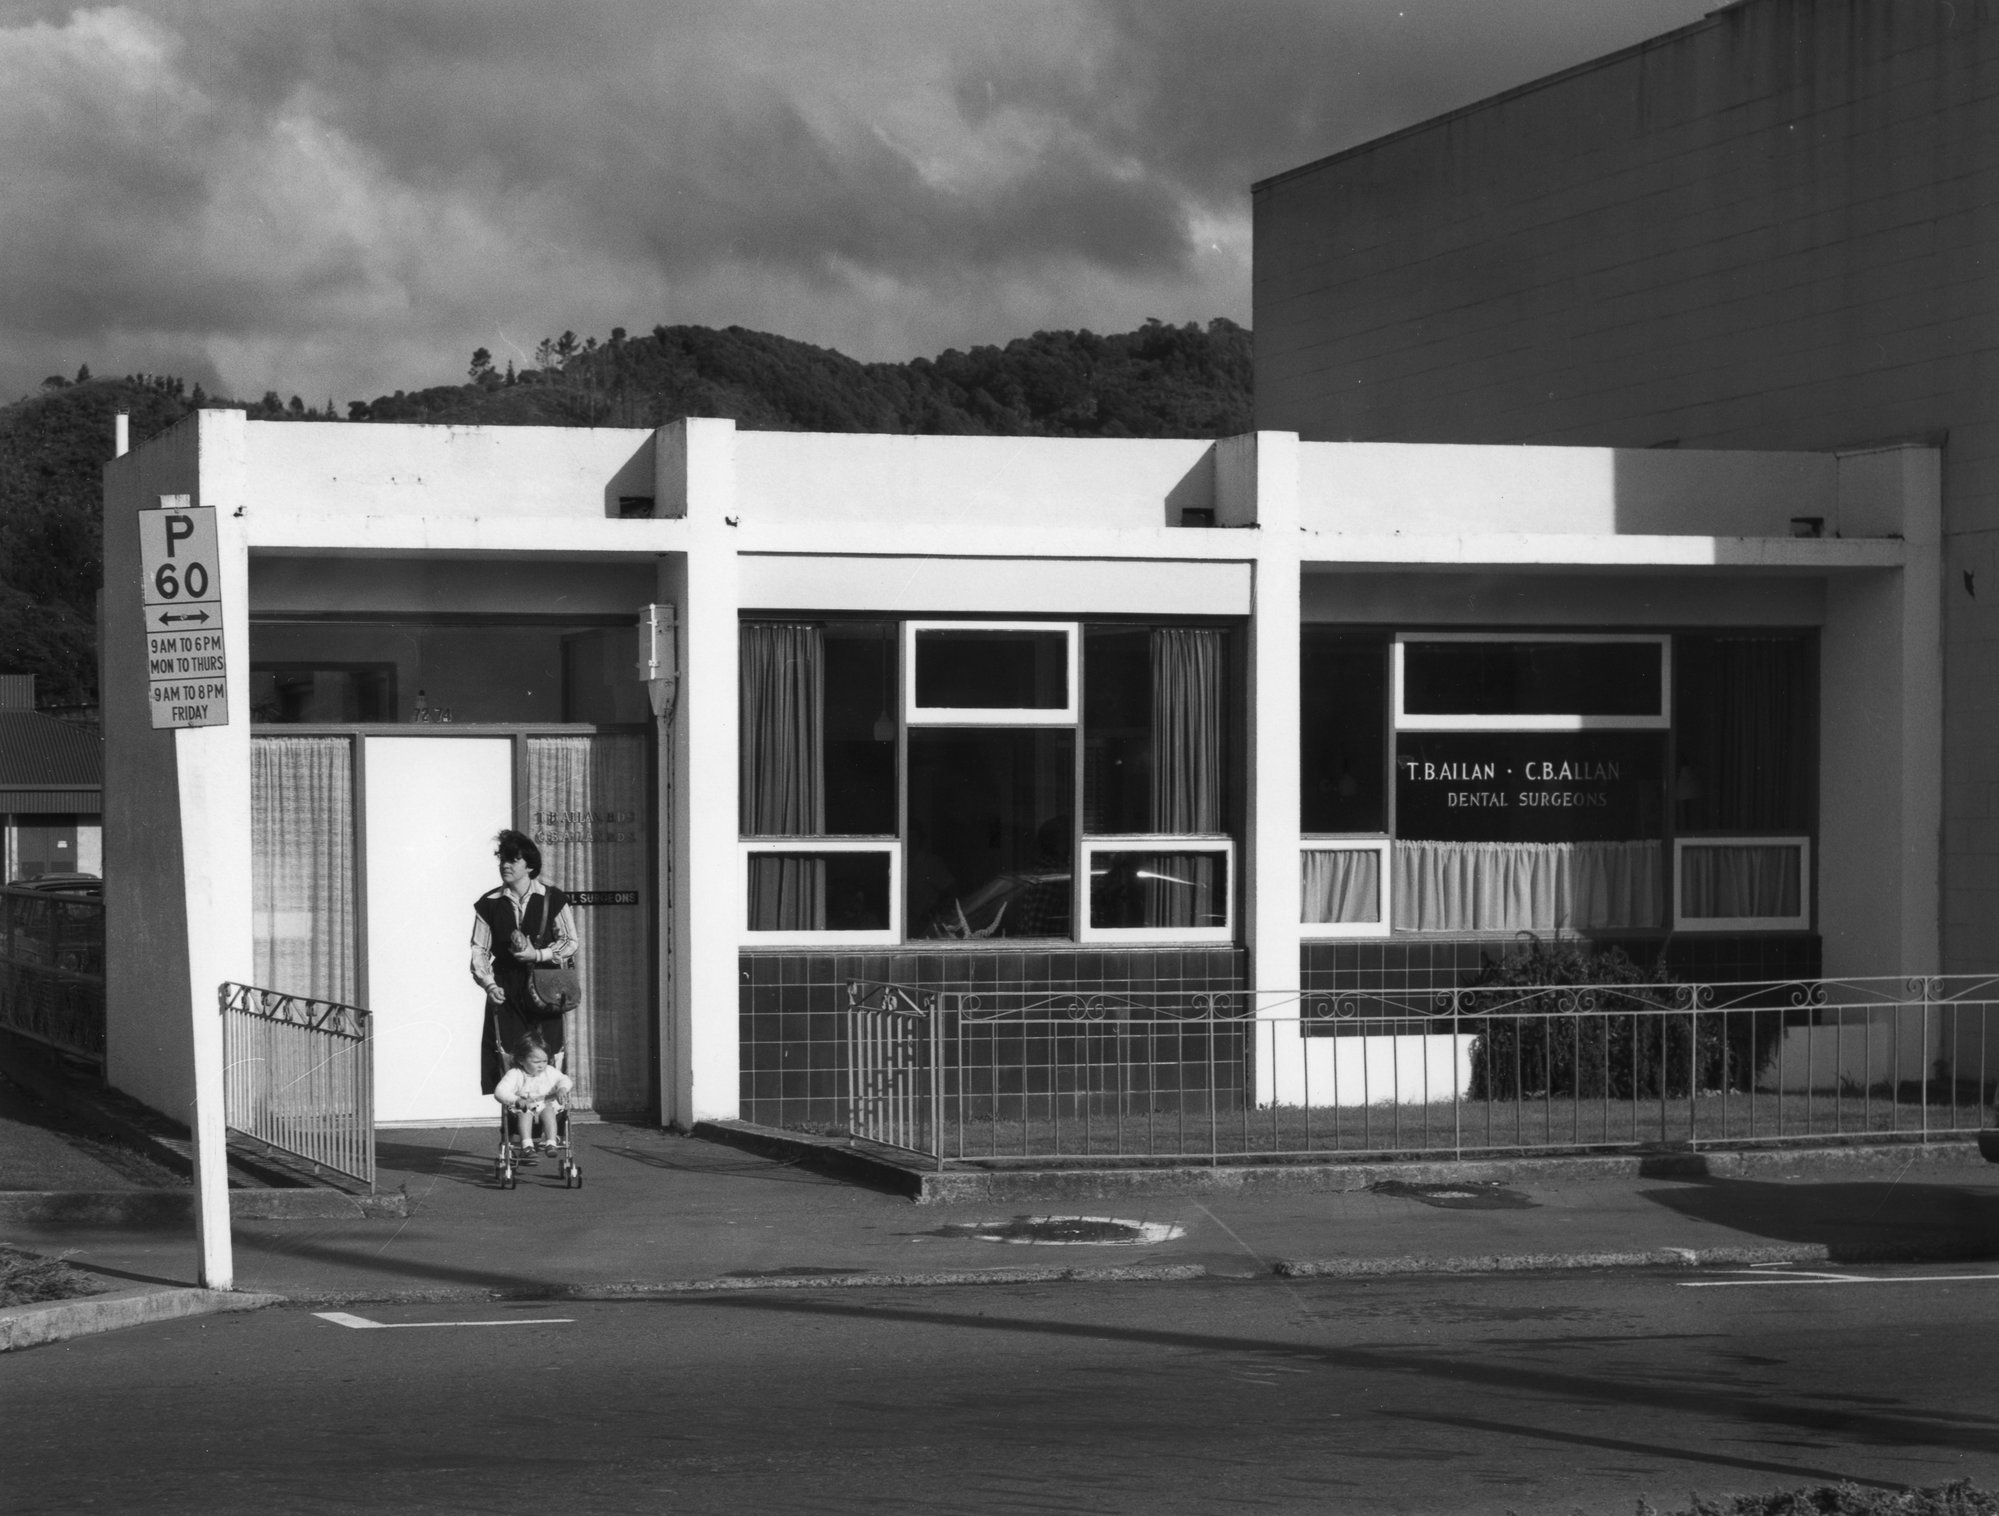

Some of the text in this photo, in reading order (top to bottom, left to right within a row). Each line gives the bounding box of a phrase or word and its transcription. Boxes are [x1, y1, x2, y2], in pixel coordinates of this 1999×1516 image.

[165, 515, 194, 558] P
[155, 562, 209, 599] 60
[180, 637, 193, 652] TO
[150, 656, 224, 674] MON TO THURS
[183, 685, 196, 700] TO
[172, 704, 208, 722] FRIDAY
[1448, 792, 1608, 808] DENTAL SURGEONS
[580, 893, 636, 904] SURGEONS
